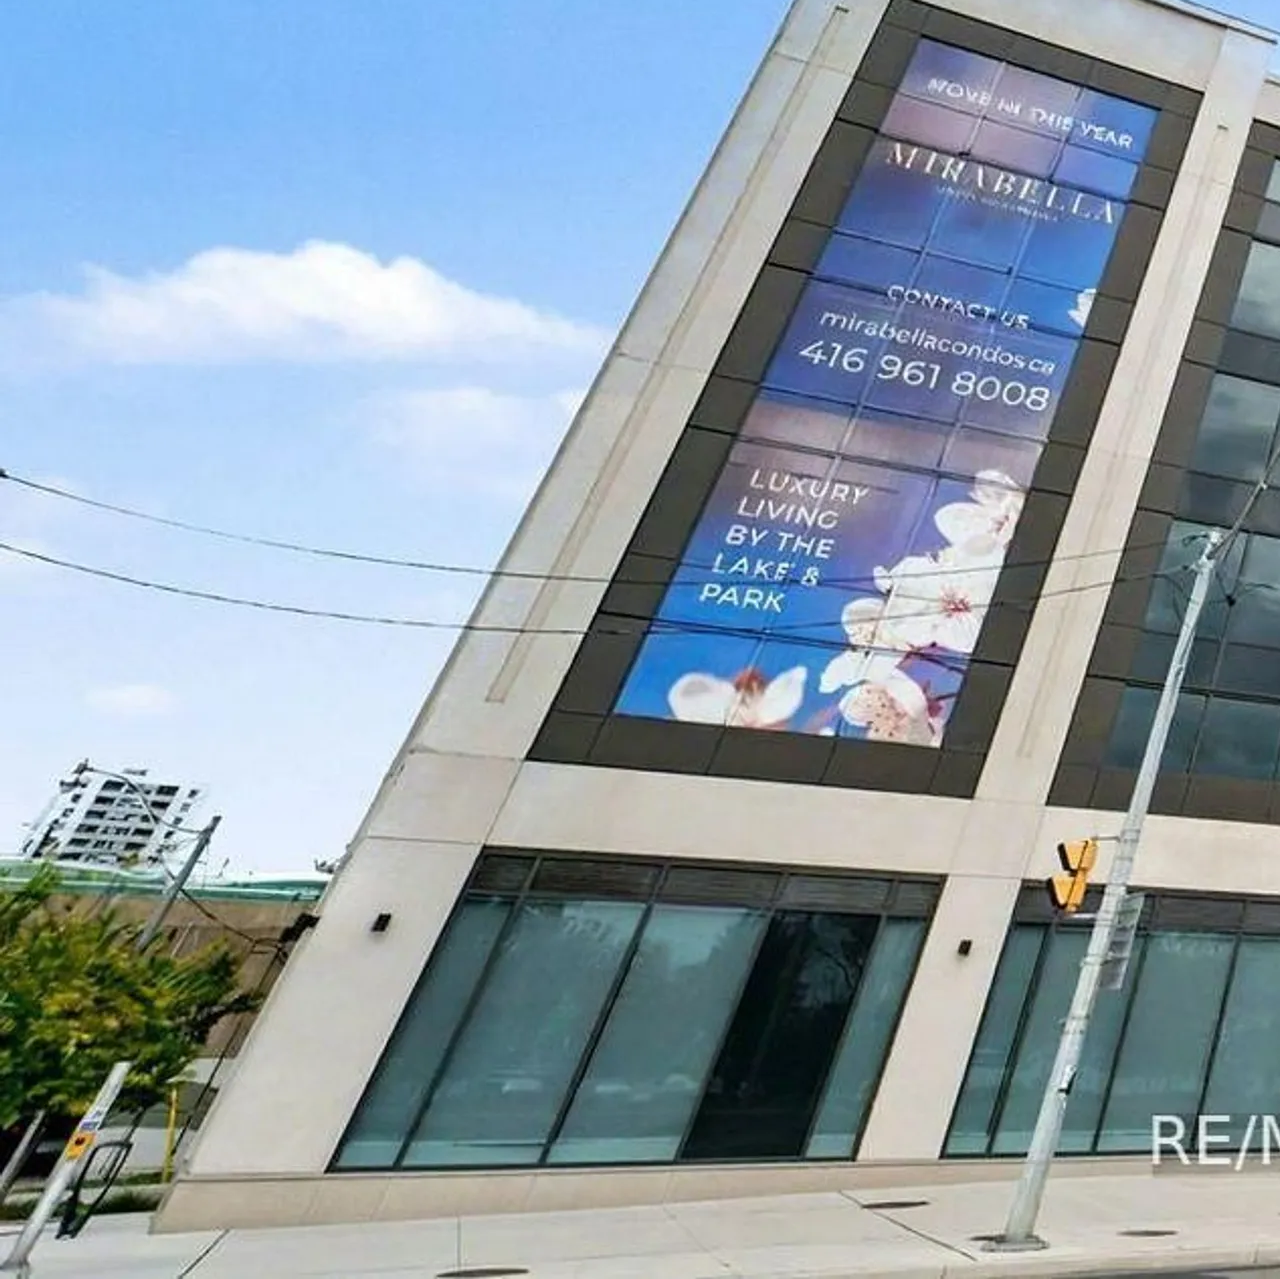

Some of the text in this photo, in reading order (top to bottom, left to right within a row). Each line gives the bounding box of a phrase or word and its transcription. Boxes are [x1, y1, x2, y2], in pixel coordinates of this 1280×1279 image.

[1081, 121, 1134, 149] YEAR
[886, 143, 1114, 224] MIRABELLA
[887, 285, 1030, 331] CONTACT US
[799, 340, 1051, 412] 416 961 8008
[750, 469, 870, 505] LUXURY
[737, 496, 839, 530] LIVING
[725, 524, 835, 560] BY THE
[711, 552, 821, 588] LAKE &
[700, 583, 786, 613] PARK
